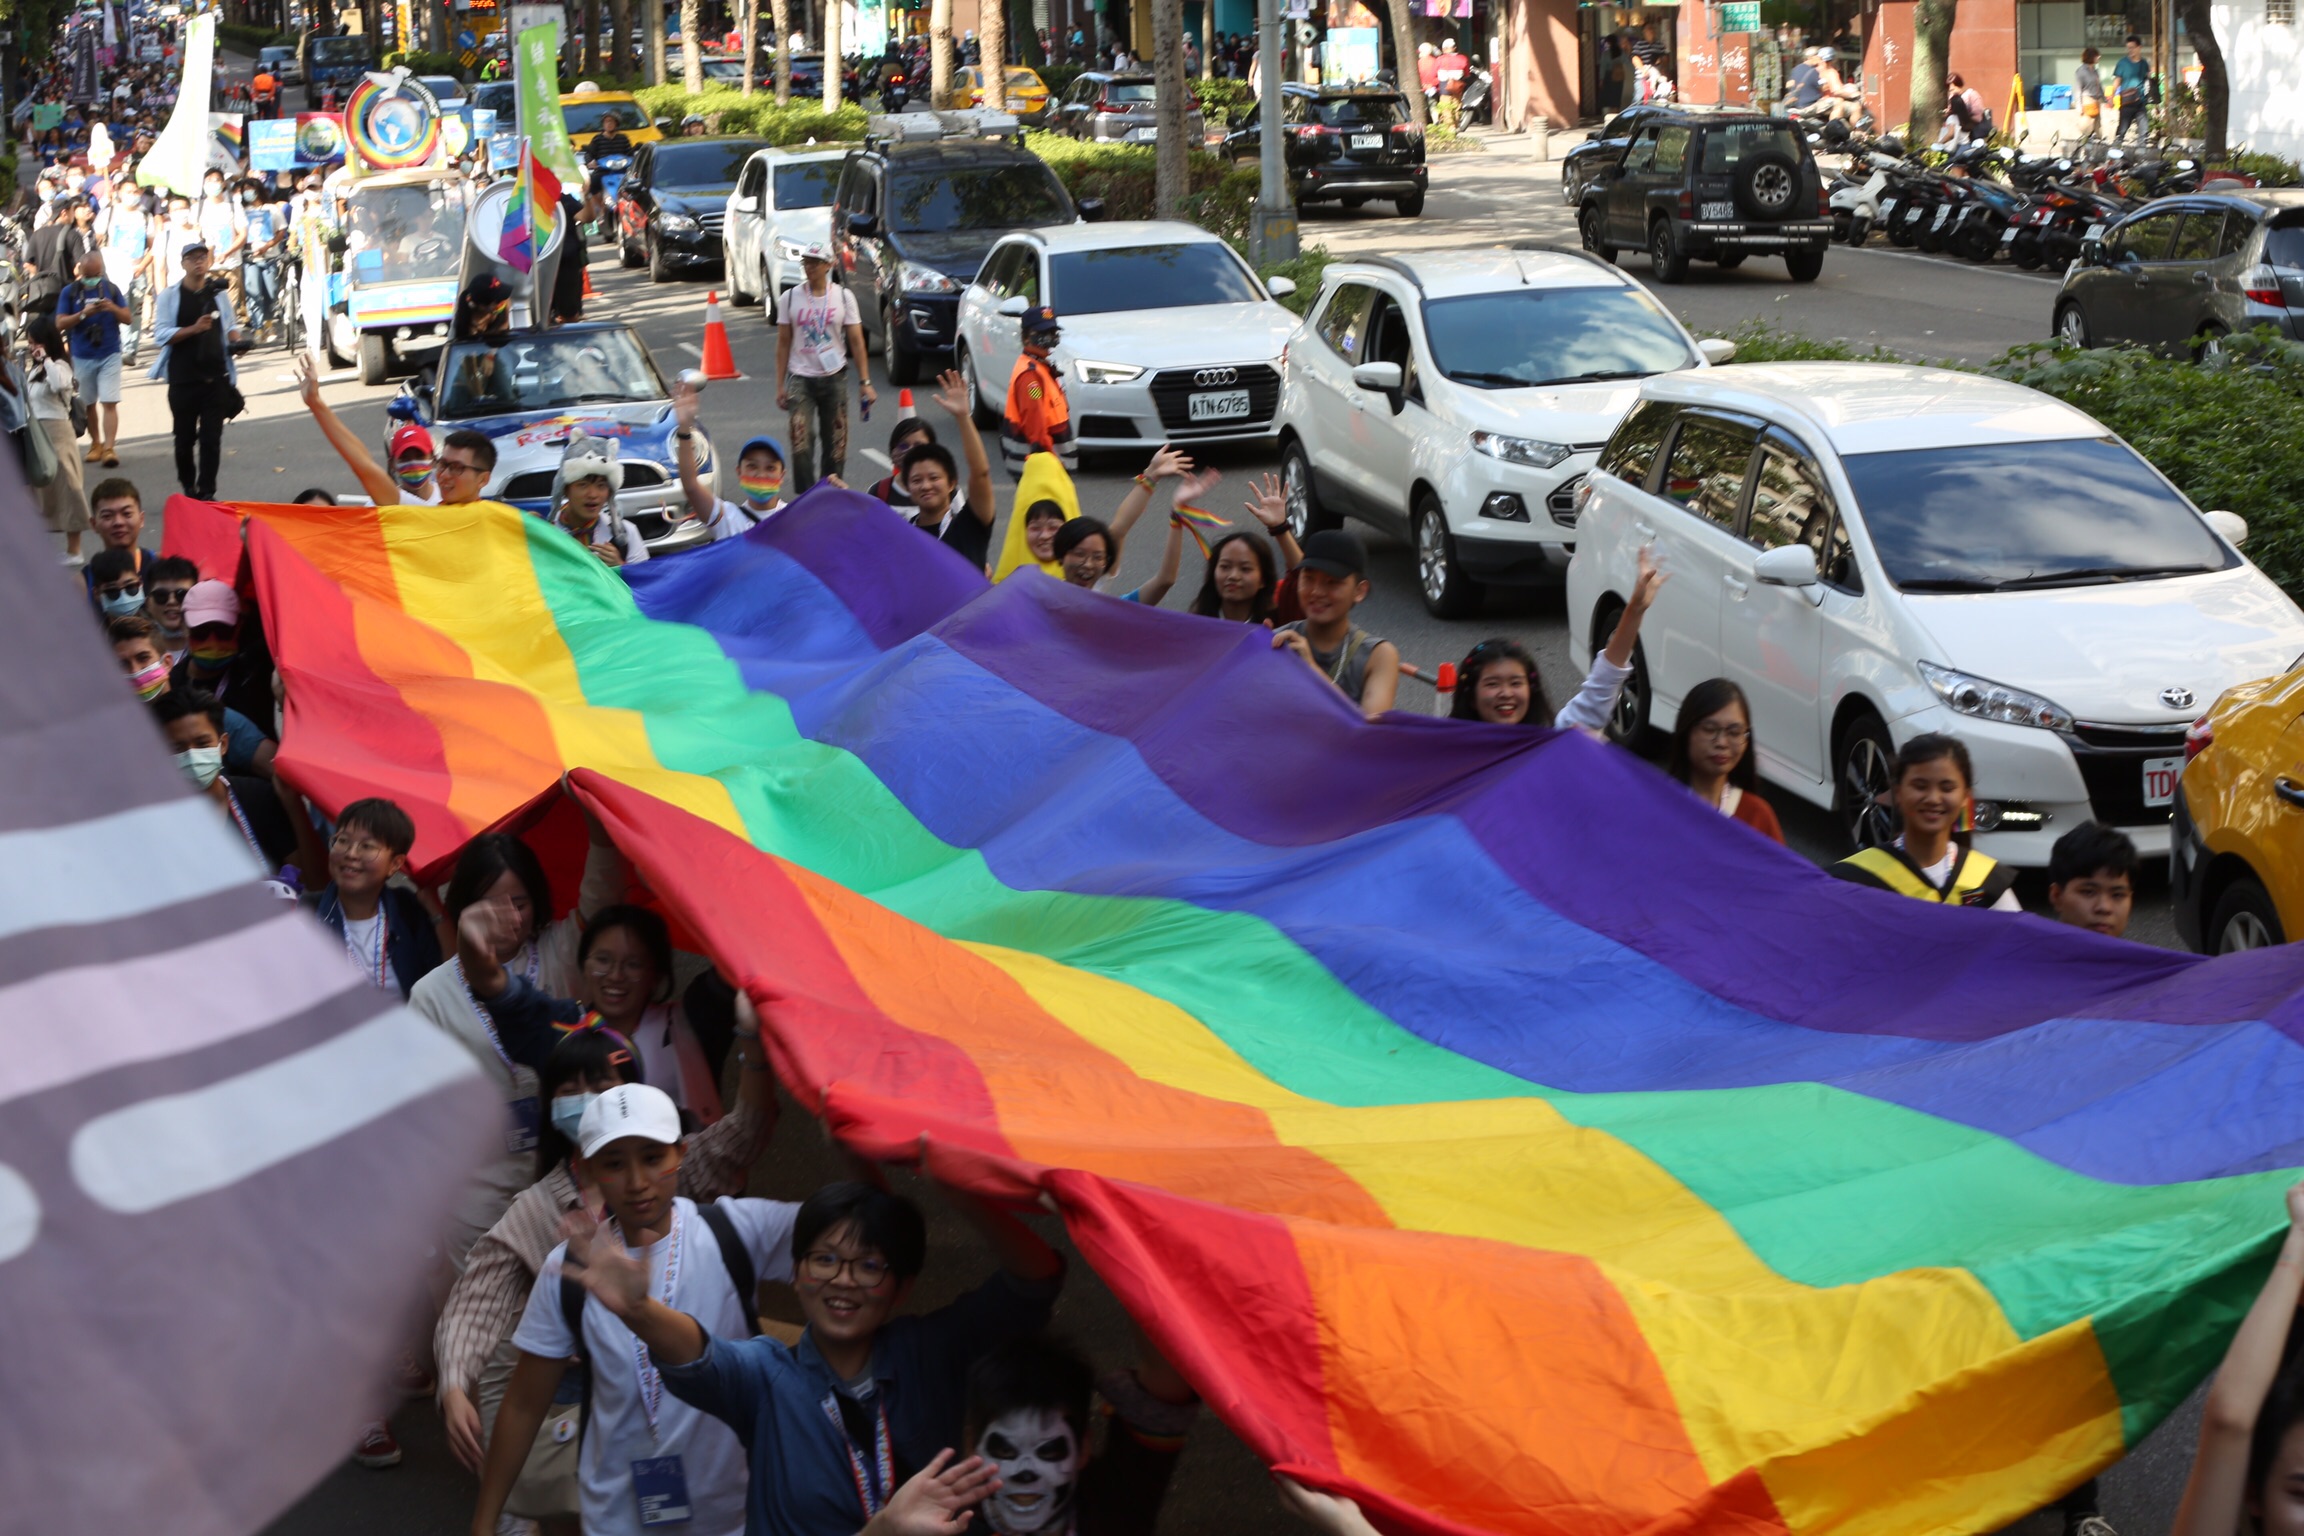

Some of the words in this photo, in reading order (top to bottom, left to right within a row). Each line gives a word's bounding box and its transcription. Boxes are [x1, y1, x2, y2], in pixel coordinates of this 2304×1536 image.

[1191, 396, 1248, 416] ATN-6785
[516, 424, 573, 447] Red
[876, 1432, 892, 1479] YEARS
